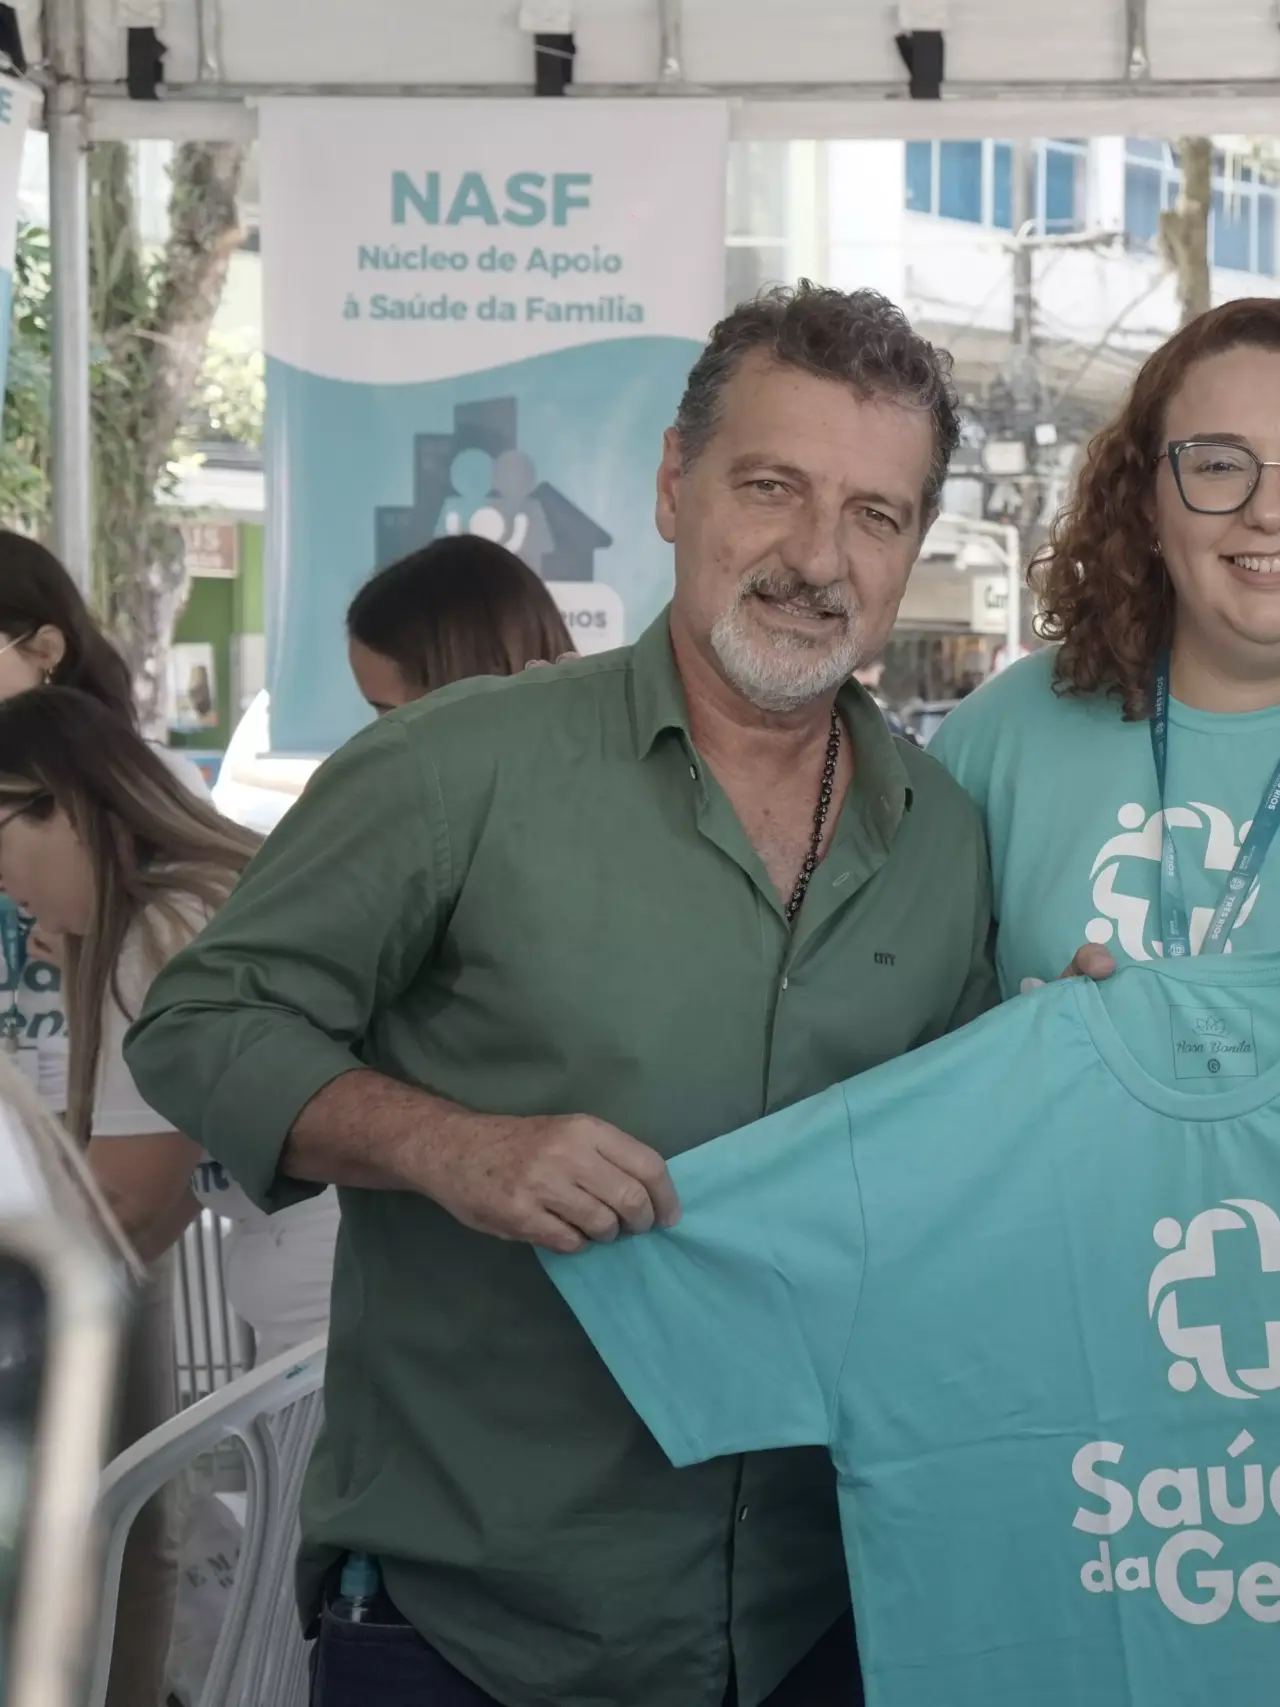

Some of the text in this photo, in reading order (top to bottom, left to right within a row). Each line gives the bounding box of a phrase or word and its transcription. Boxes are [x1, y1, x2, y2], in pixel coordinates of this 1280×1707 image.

[391, 171, 592, 227] NASF
[357, 244, 623, 279] Núcleo de Apoio
[342, 292, 645, 323] à Saúde da Família
[1080, 1540, 1151, 1593] da
